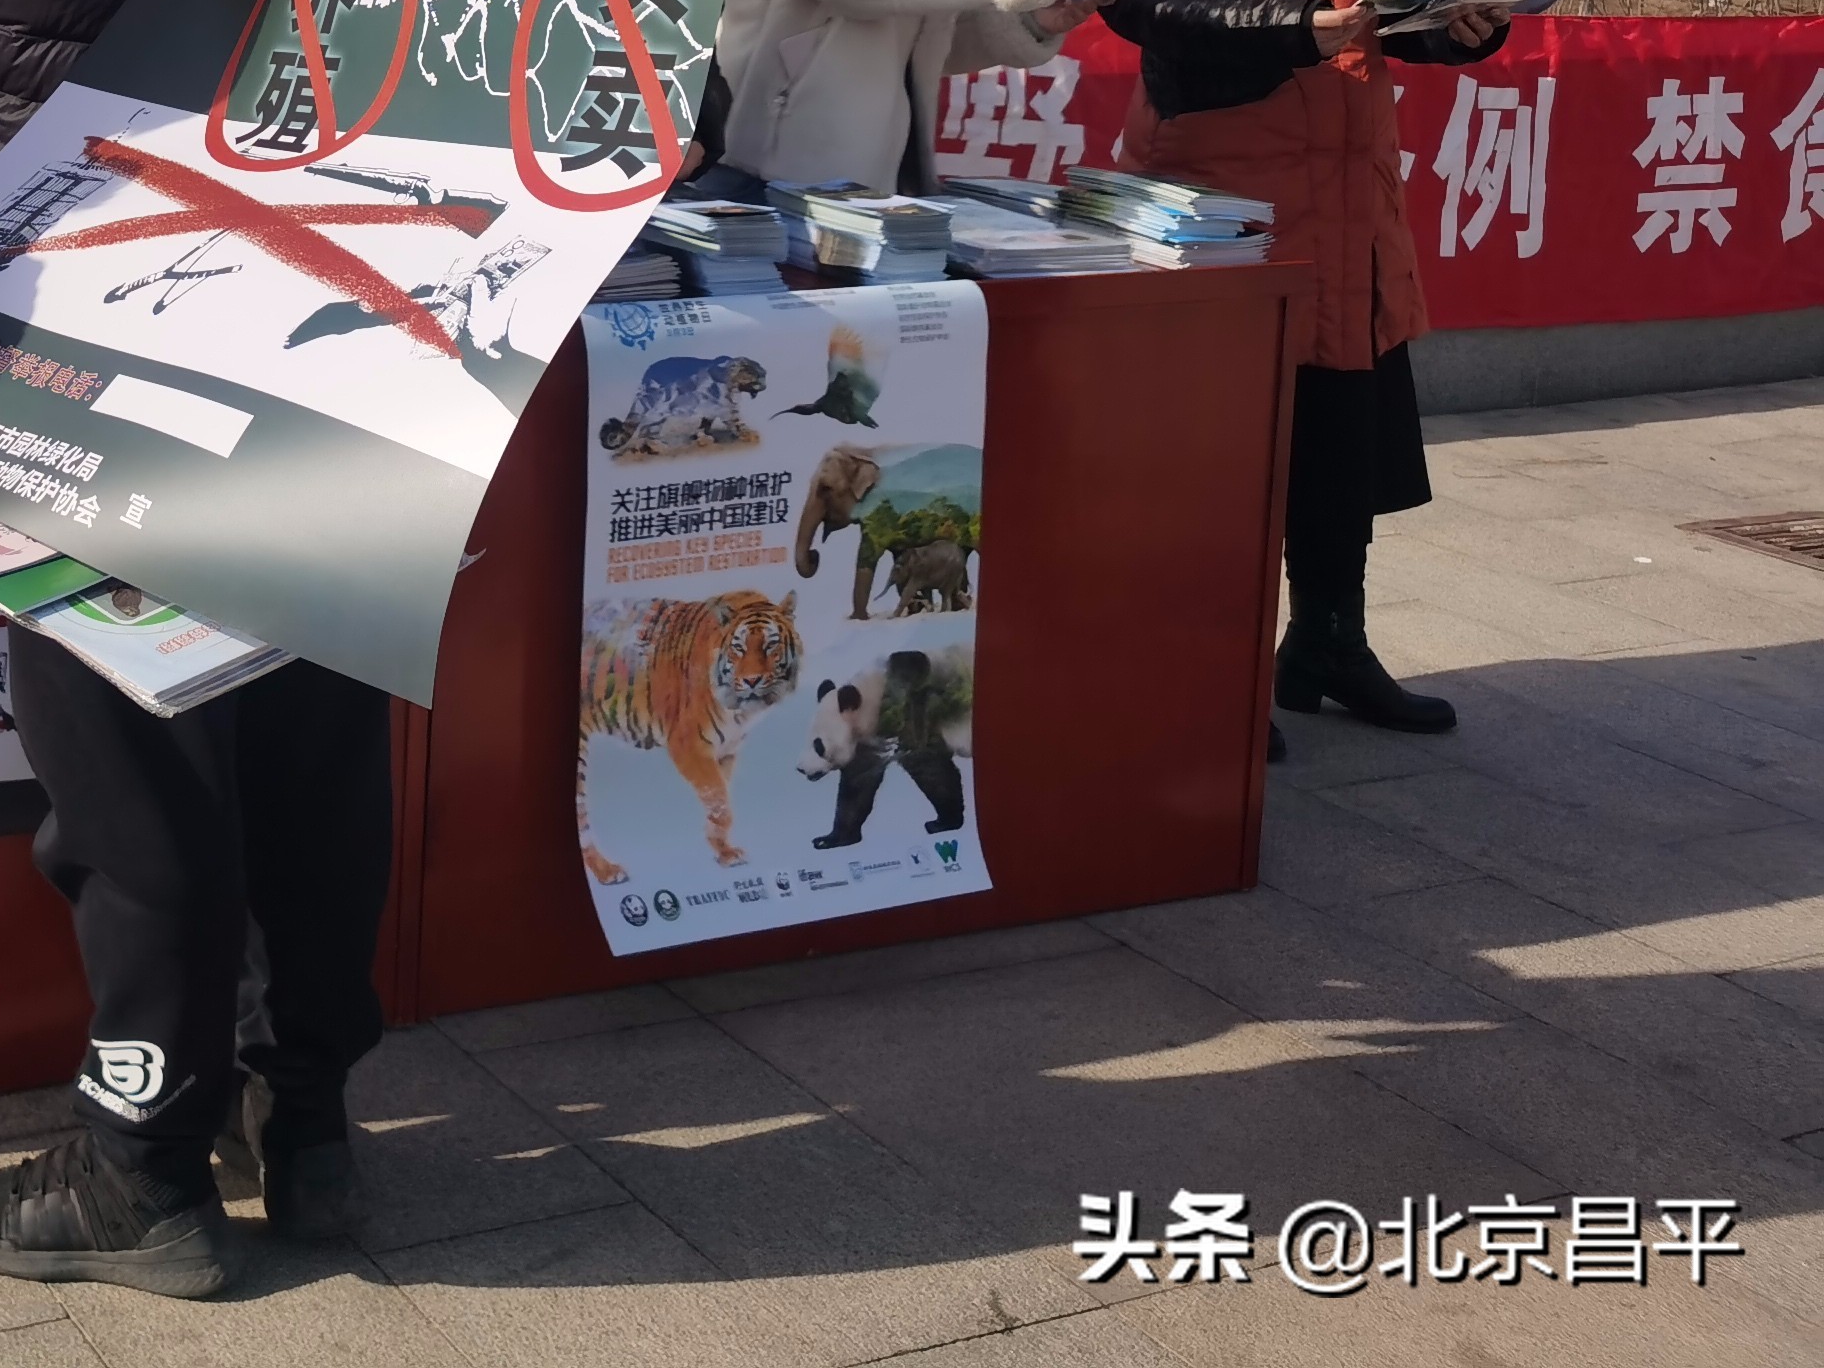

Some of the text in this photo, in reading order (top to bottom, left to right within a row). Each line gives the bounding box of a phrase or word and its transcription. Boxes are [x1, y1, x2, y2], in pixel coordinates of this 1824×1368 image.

[119, 492, 153, 530] 宣
[609, 498, 789, 543] 推进美丽中国建设
